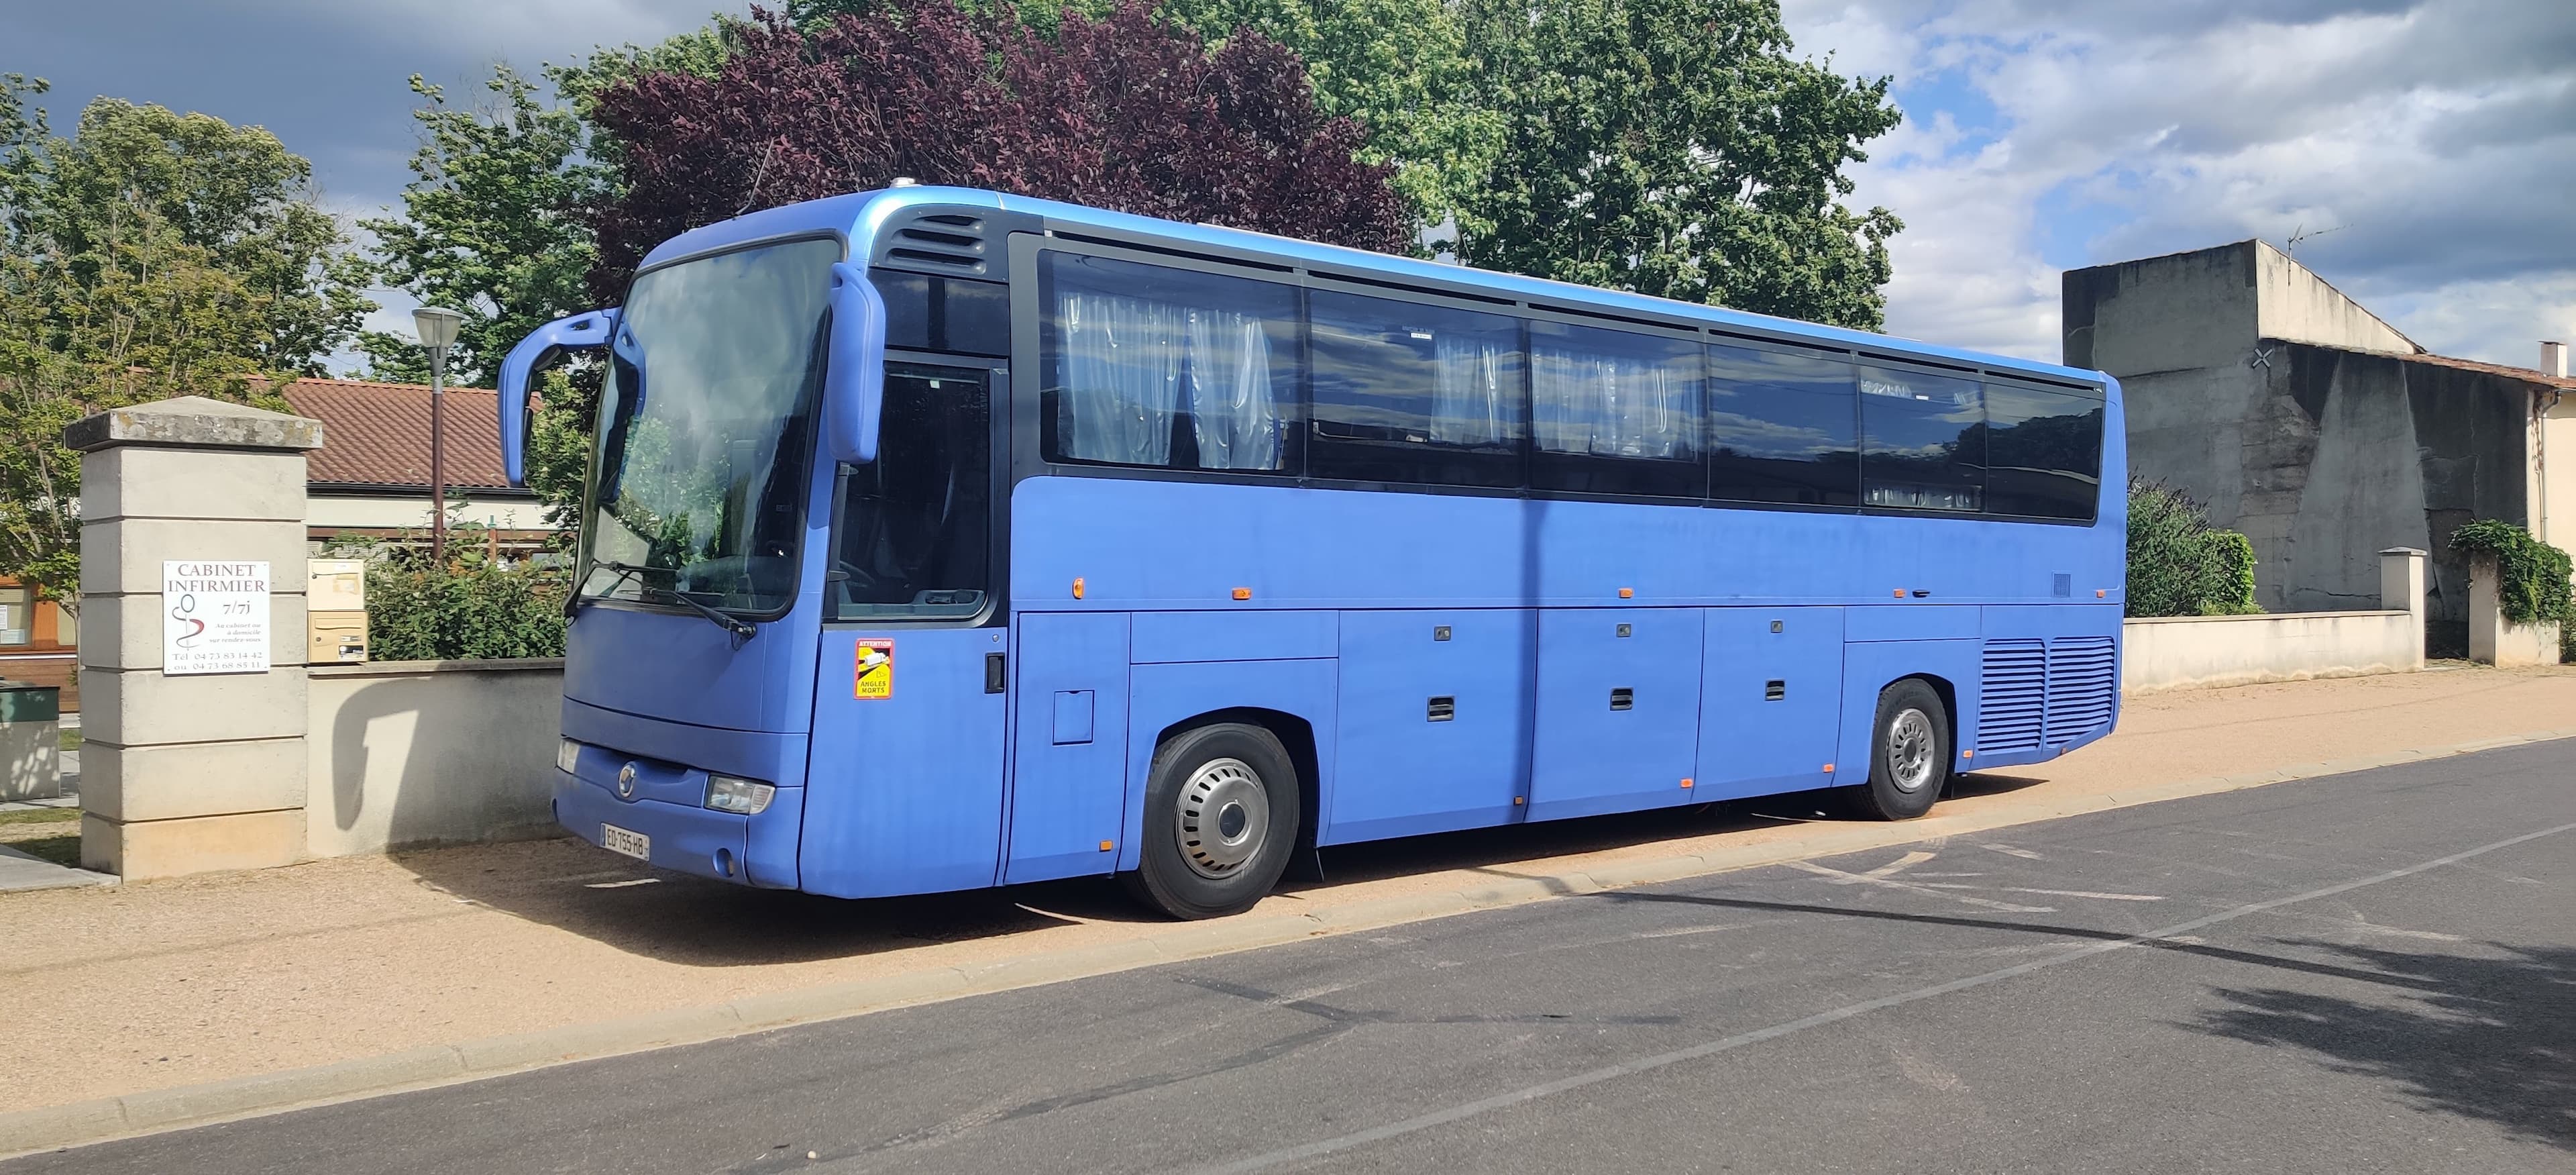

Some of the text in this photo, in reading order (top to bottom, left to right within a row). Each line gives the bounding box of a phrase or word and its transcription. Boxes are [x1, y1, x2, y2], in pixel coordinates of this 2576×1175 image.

[178, 564, 256, 576] CABINET
[168, 580, 266, 592] INFIRMIER
[223, 601, 250, 615] 7/7j
[209, 652, 220, 660] 73
[607, 829, 643, 856] ED-755-HB
